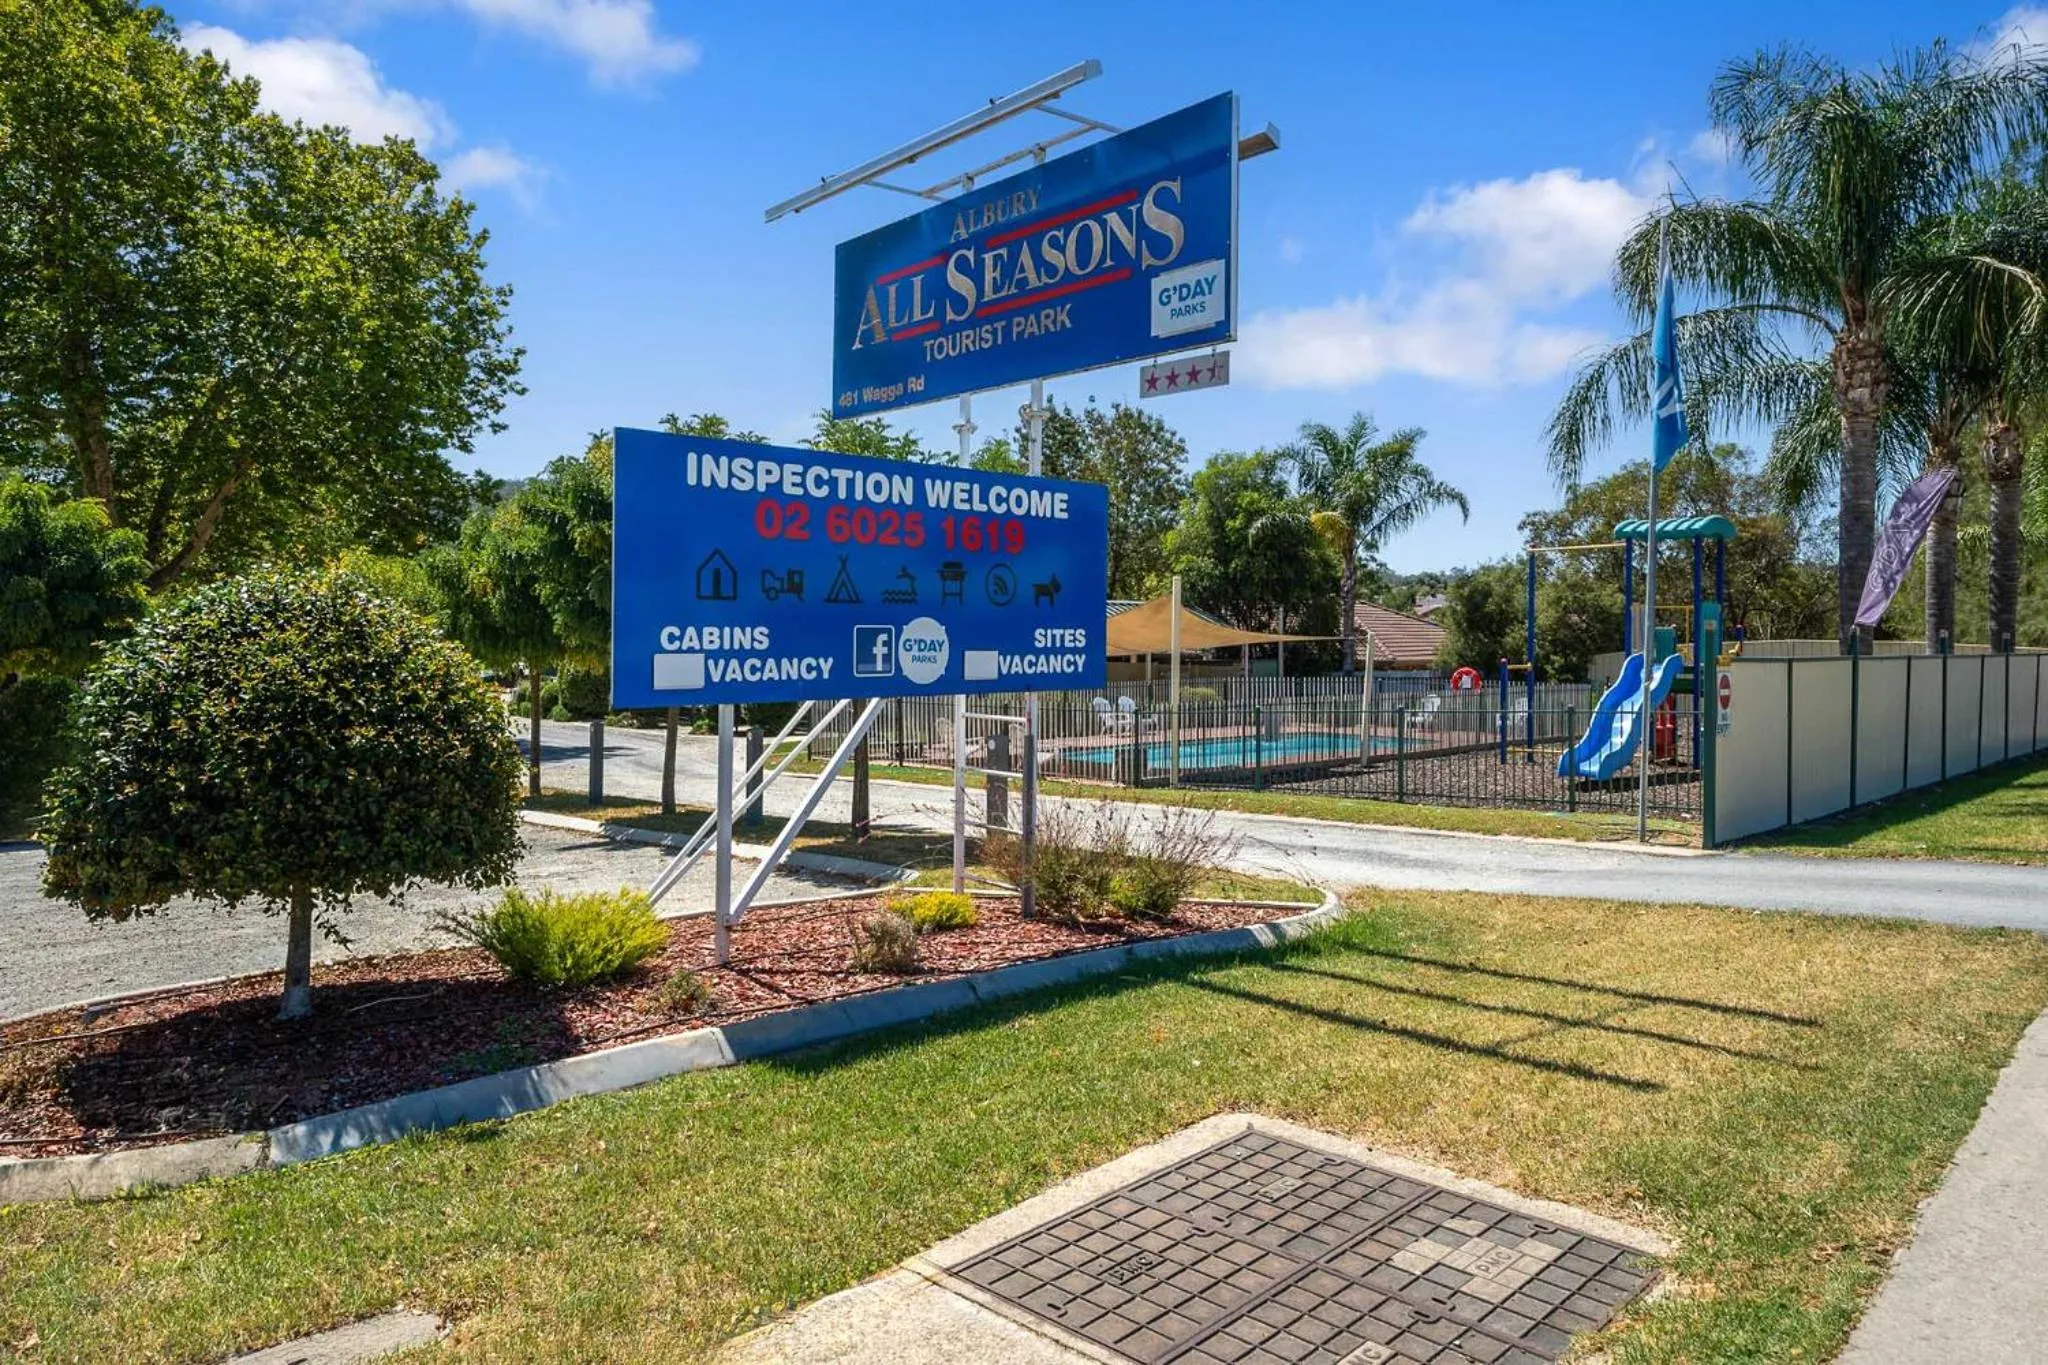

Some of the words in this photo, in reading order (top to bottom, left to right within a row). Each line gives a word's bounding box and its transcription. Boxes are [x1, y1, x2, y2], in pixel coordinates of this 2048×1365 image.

[950, 185, 1042, 243] ALBURY
[852, 272, 935, 350] ALL
[946, 175, 1185, 324] SEASONS
[1158, 275, 1217, 307] G'DAY
[1170, 301, 1207, 320] PARKS
[923, 321, 1006, 363] TOURIST
[1012, 303, 1073, 342] PARK
[862, 383, 904, 403] Wagga
[907, 374, 925, 393] Rd
[687, 452, 913, 506] INSPECTION
[924, 478, 1069, 519] WELCOME
[755, 498, 811, 541] 02
[825, 505, 925, 548] 6025
[941, 514, 1025, 555] 1619
[660, 626, 770, 651] CABINS
[903, 638, 945, 652] G'DAY
[1034, 628, 1087, 648] SITES
[707, 657, 834, 683] VACANCY
[911, 655, 938, 664] PARKS
[999, 654, 1087, 675] VACANCY
